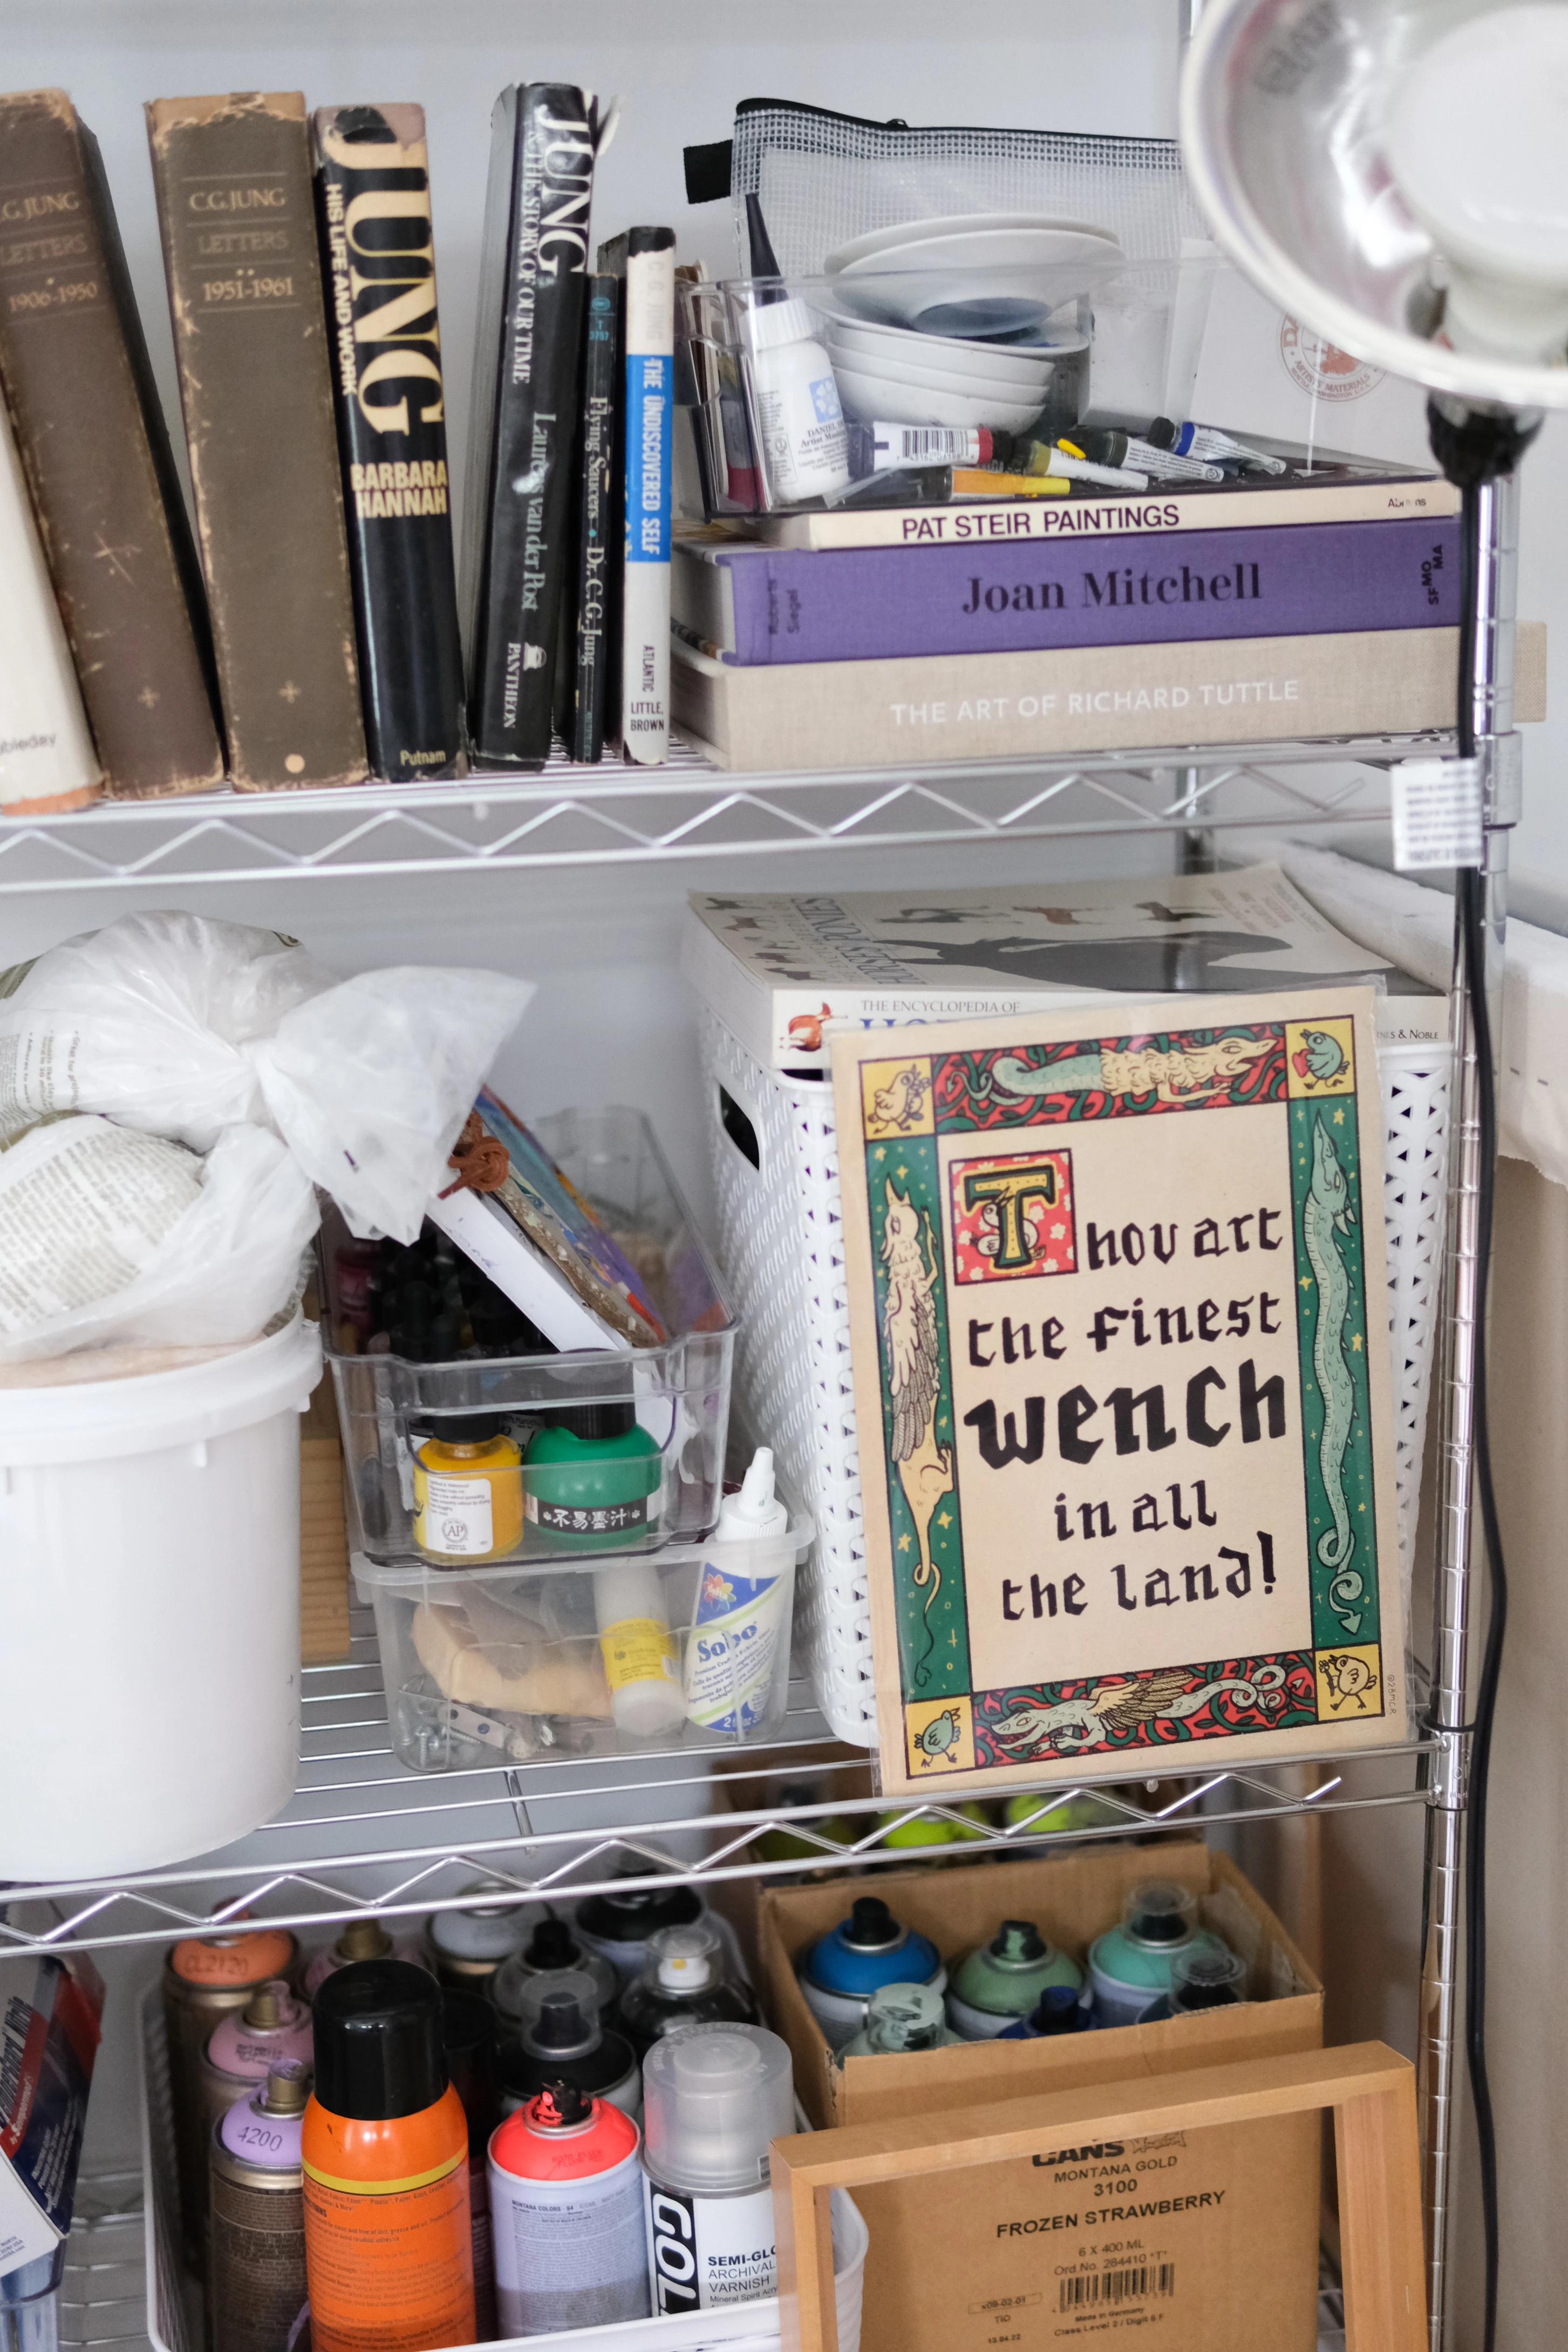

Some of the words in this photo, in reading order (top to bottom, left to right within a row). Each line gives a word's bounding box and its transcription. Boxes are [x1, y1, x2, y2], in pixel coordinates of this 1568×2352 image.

[325, 183, 344, 217] HIS
[534, 104, 595, 276] JUNG
[328, 220, 347, 271] LIFE
[519, 195, 540, 257] STORY
[203, 277, 295, 301] 1951-1961
[324, 123, 444, 435] JUNG
[519, 258, 537, 286] OF
[332, 272, 351, 325] AND
[516, 287, 535, 330] OUR
[336, 329, 359, 396] WORK
[513, 332, 533, 385] TIME
[643, 357, 663, 389] THE
[641, 395, 663, 512] UNDISCOVERED
[351, 460, 448, 492] BARBARA
[587, 456, 606, 520] Saucers
[357, 489, 448, 519] HANNAH
[902, 516, 944, 540] PAT
[955, 513, 1031, 537] STEIR
[1044, 505, 1180, 533] PAINTINGS
[640, 517, 661, 556] SELF
[521, 570, 546, 612] Post
[962, 574, 1066, 616] Joan
[1081, 563, 1264, 609] Mitchell
[503, 642, 522, 729] PANTHEON
[643, 645, 655, 693] ATLANTIC
[630, 702, 664, 714] LITTLE,
[890, 703, 946, 726] THE
[957, 698, 1009, 721] ART
[1017, 694, 1057, 717] OF
[1068, 686, 1190, 715] RICHARD
[1198, 680, 1299, 706] TUTTLE
[630, 719, 664, 731] BROWN
[400, 749, 447, 767] Putnam
[861, 1000, 889, 1013] THE
[893, 1000, 993, 1013] ENCYCLOPEDIA
[997, 1001, 1021, 1013] OF
[1398, 1029, 1407, 1039] &
[1193, 1208, 1284, 1258] art
[969, 1315, 1067, 1367] the
[1086, 1291, 1282, 1353] finest
[1053, 1491, 1116, 1543] in
[1131, 1479, 1218, 1532] all
[1001, 1570, 1089, 1621] the
[1110, 1530, 1277, 1611] land!
[237, 2125, 283, 2152] 4200
[1053, 2163, 1131, 2184] MONTANA
[1135, 2155, 1178, 2173] GOLD
[1094, 2178, 1138, 2197] 3100
[996, 2213, 1078, 2238] FROZEN
[1085, 2190, 1226, 2226] STRAWBERRY
[1101, 2241, 1123, 2253] 400
[1126, 2239, 1144, 2250] ML
[708, 2260, 776, 2280] ARCHIVAL
[708, 2274, 770, 2294] VARNISH
[710, 2294, 739, 2303] Mineral
[741, 2292, 761, 2302] Spirit
